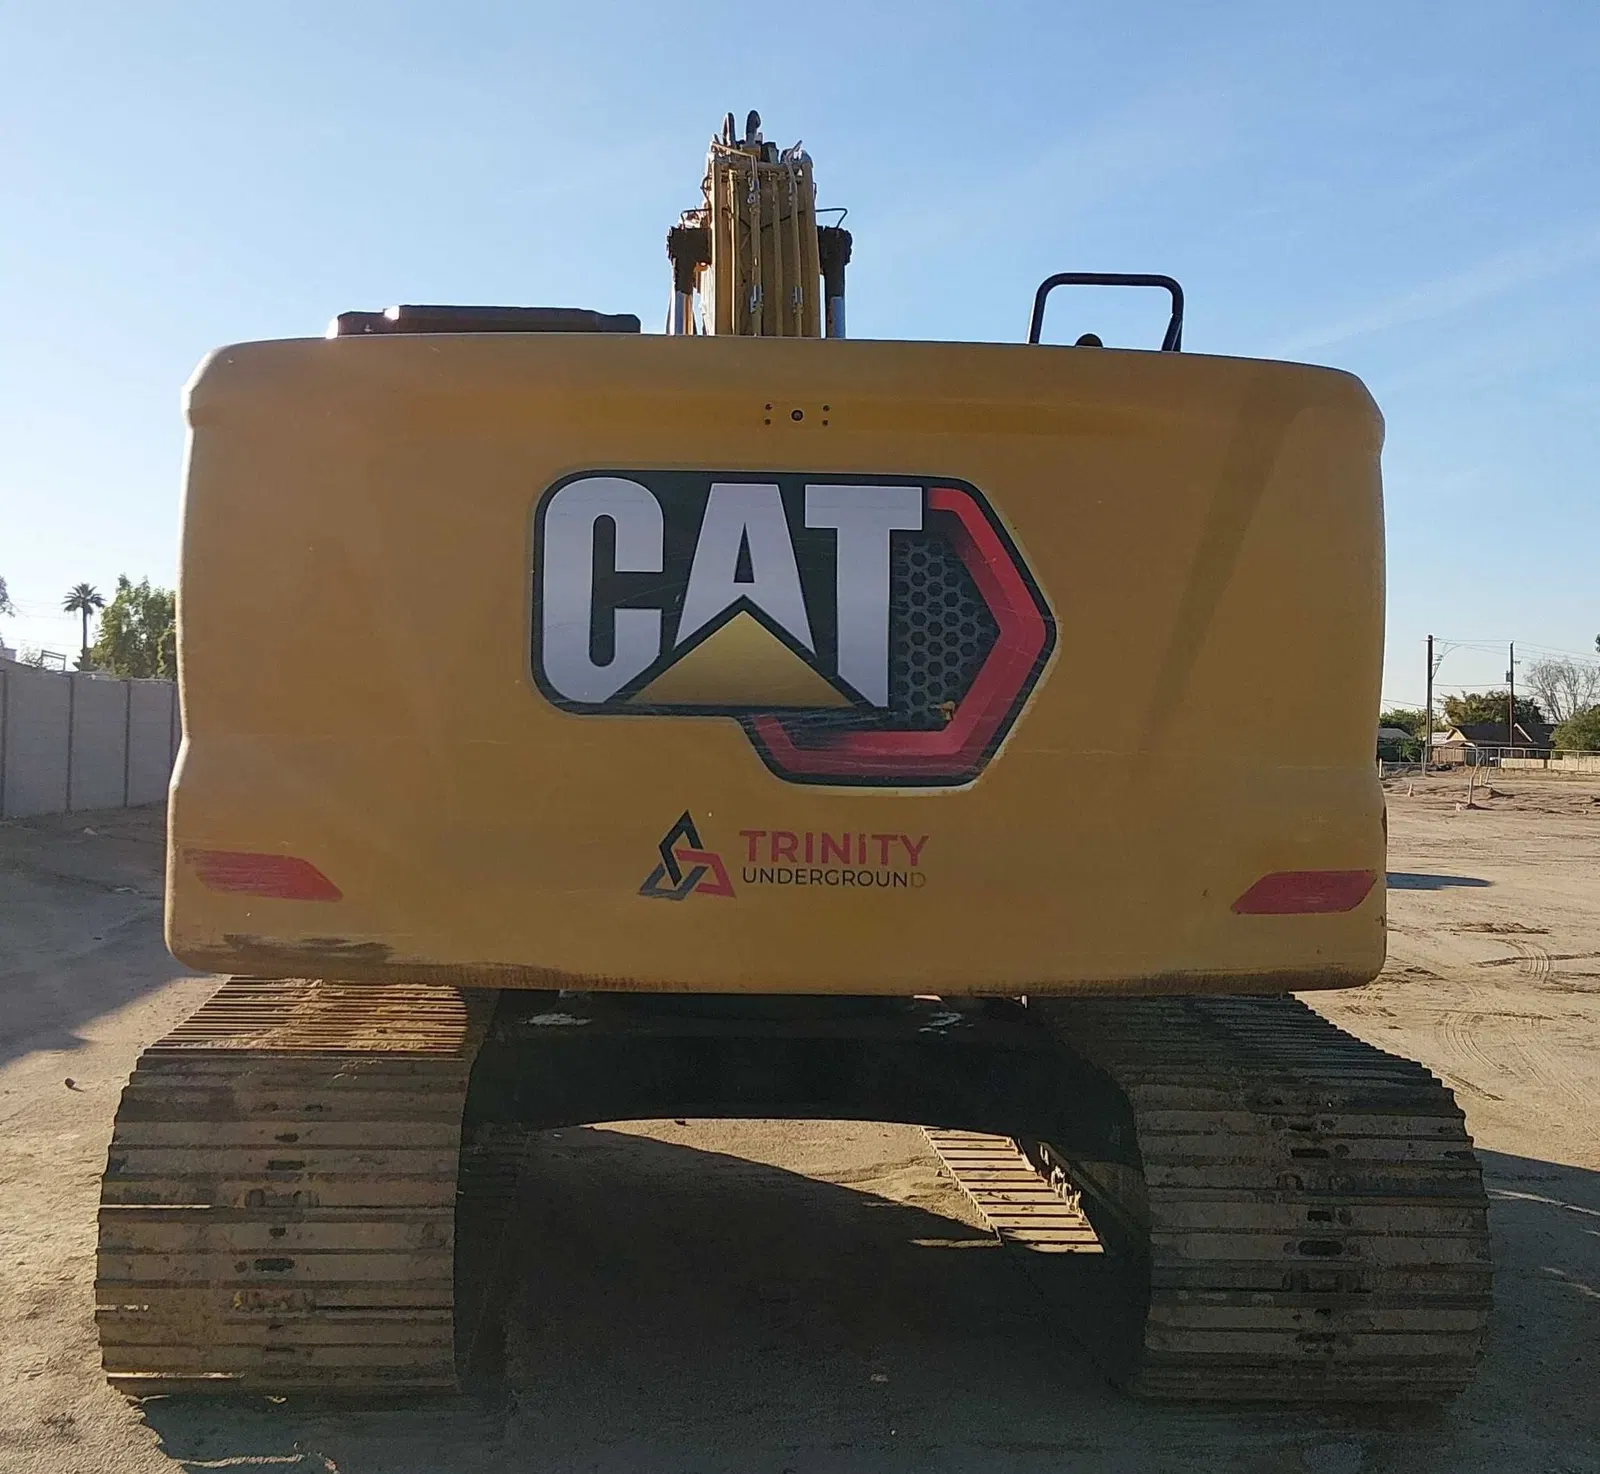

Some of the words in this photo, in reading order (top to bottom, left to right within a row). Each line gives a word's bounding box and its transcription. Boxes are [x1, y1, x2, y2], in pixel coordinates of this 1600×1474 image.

[543, 476, 922, 707] CAT
[740, 830, 929, 867] TRINITY
[742, 867, 926, 888] UNDERGROUND
